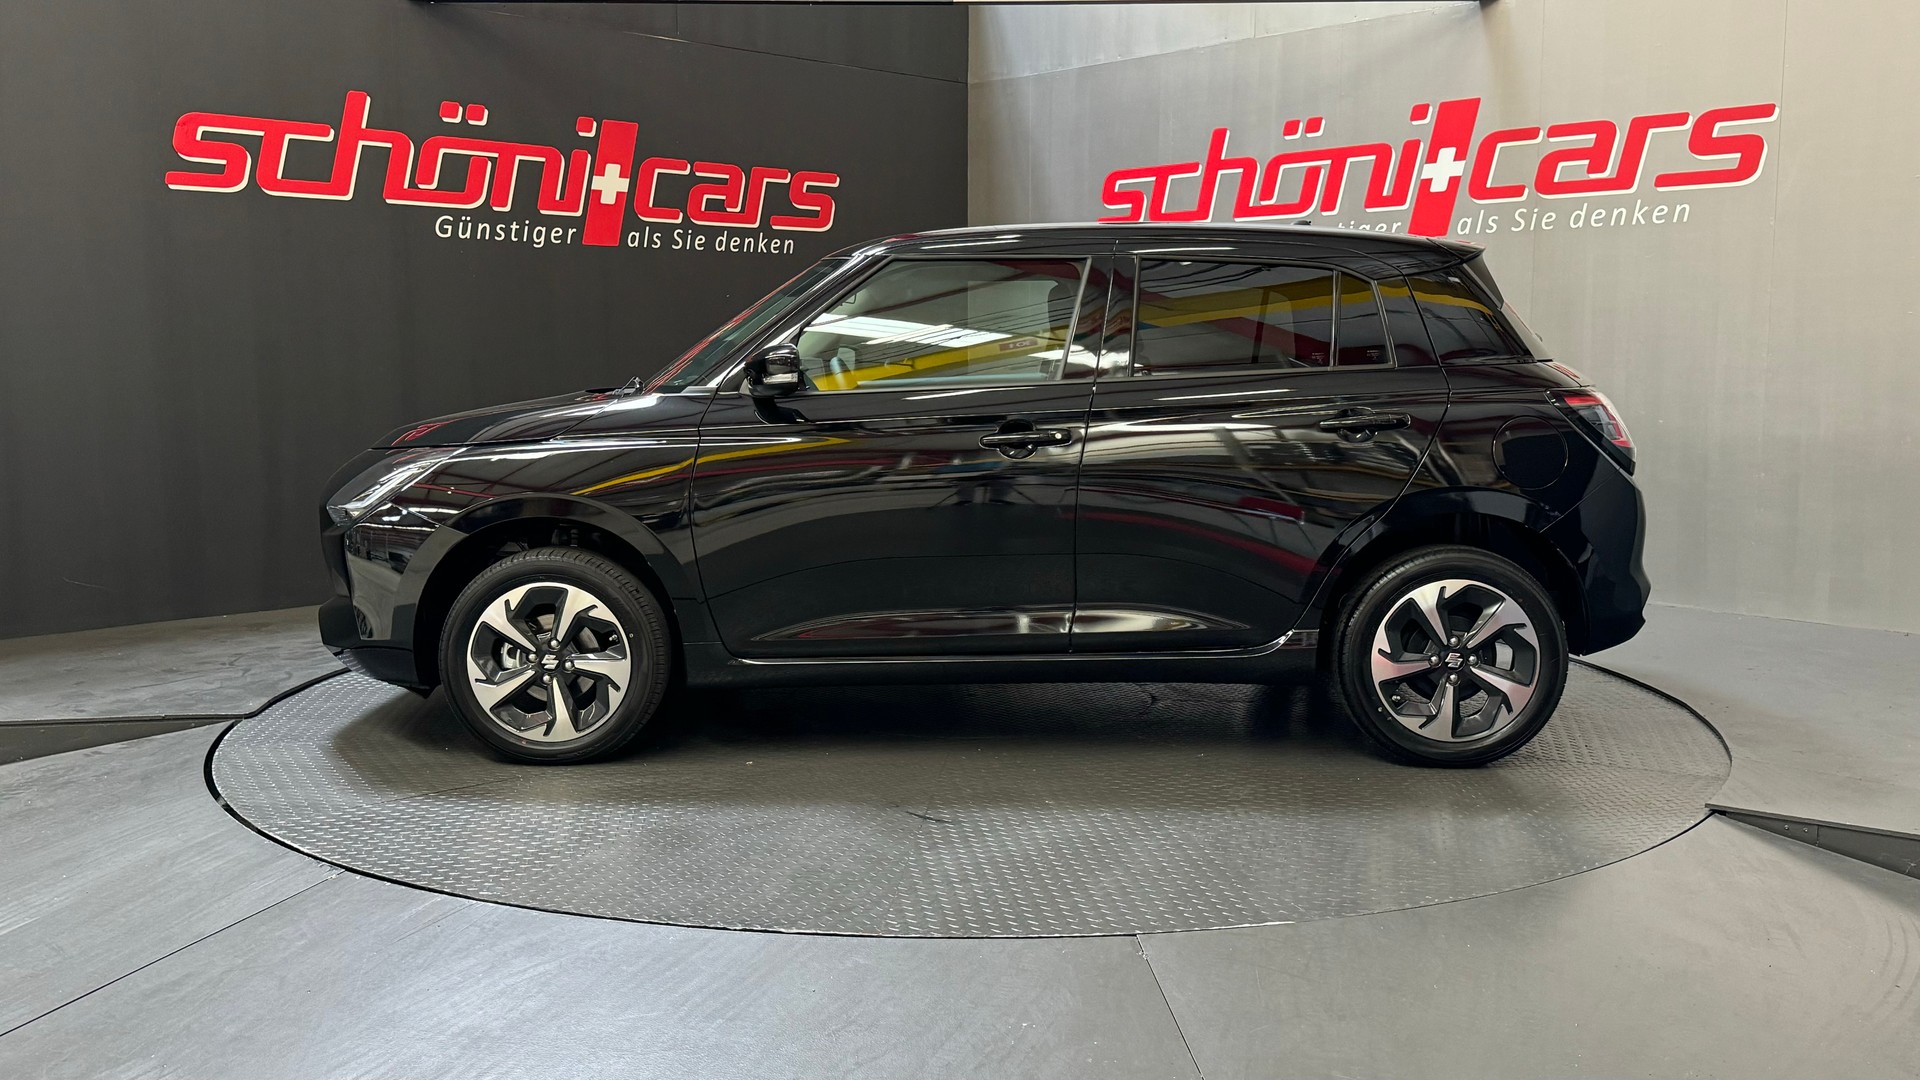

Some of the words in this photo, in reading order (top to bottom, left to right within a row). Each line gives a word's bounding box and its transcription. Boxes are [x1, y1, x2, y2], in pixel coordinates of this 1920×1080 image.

[1467, 102, 1779, 204] cars
[634, 156, 840, 233] cars
[1456, 209, 1499, 235] als
[1510, 207, 1557, 232] Sie
[1569, 199, 1691, 229] denken
[434, 214, 577, 248] Günstiger
[626, 225, 662, 249] als
[671, 228, 706, 251] Sie
[715, 230, 795, 255] denken
